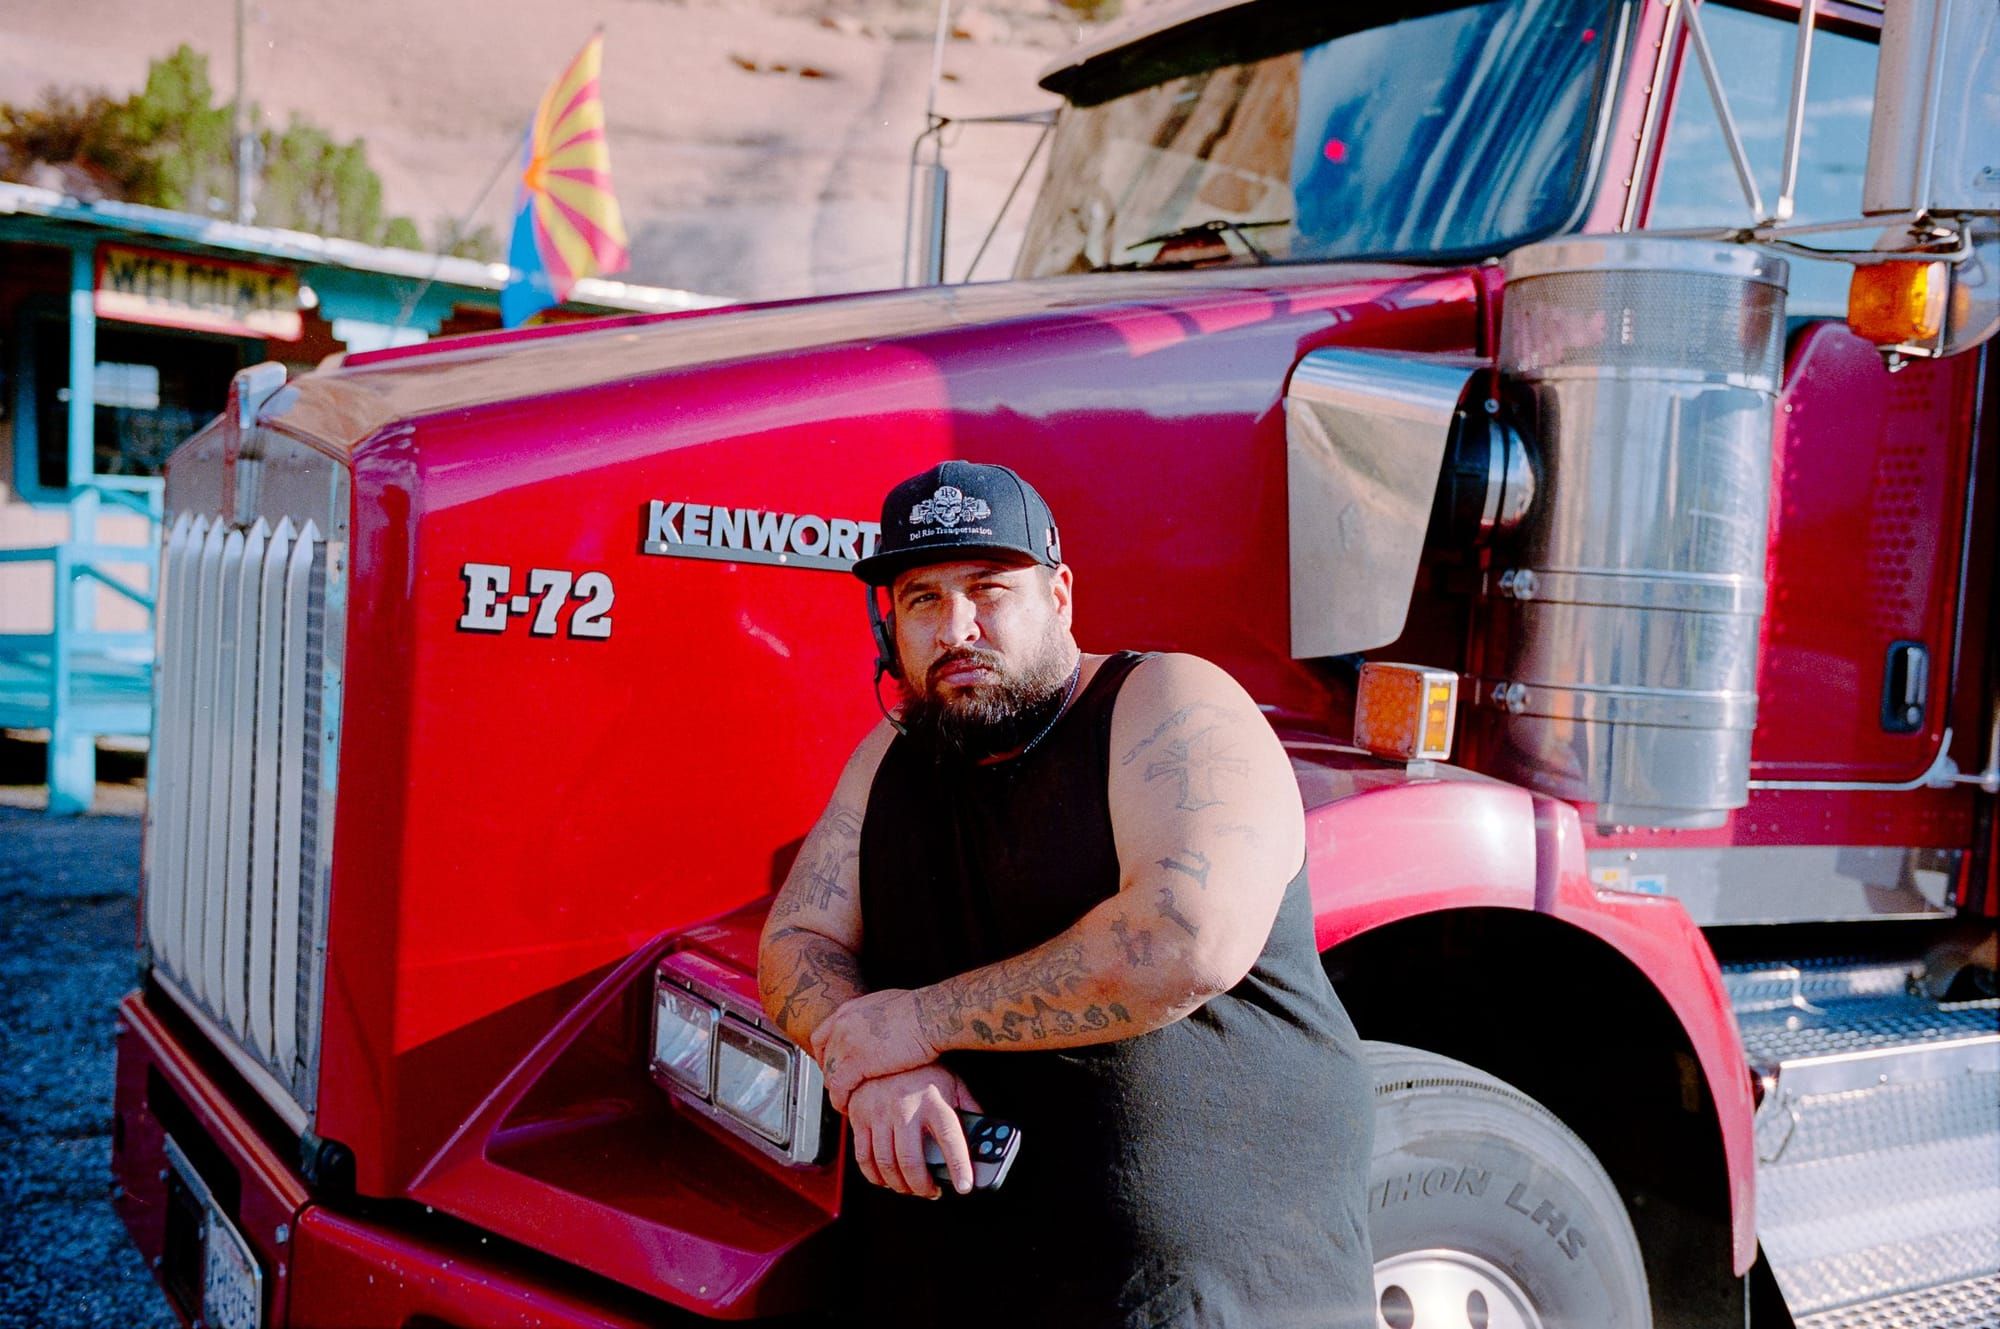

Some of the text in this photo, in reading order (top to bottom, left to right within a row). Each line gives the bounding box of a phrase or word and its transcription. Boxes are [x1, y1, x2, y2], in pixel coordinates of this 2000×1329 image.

[909, 530, 921, 541] Del
[922, 528, 935, 538] Rio
[459, 562, 615, 638] E-72
[1504, 1182, 1587, 1261] LHS
